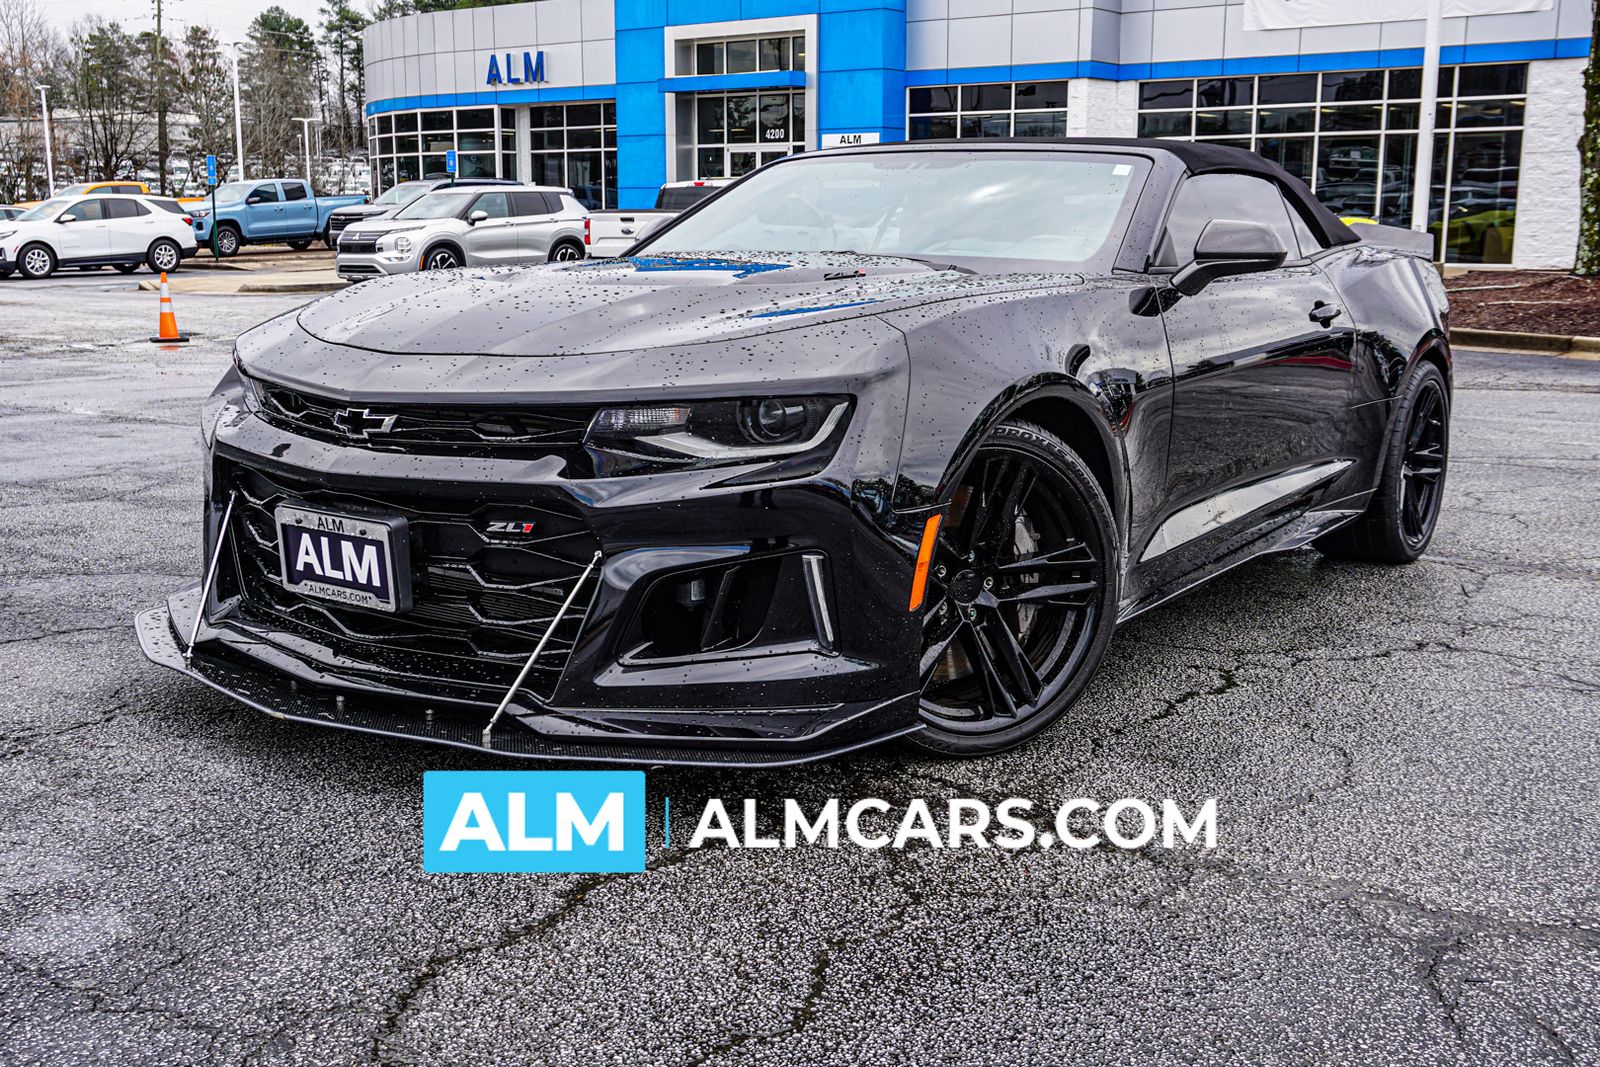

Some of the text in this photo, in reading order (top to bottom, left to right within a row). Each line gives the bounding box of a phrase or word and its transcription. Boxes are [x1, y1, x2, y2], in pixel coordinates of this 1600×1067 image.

[486, 50, 545, 85] ALM
[765, 128, 785, 139] 4200
[840, 134, 862, 145] ALM
[317, 516, 345, 533] ALM
[486, 521, 534, 533] ZL1
[295, 532, 381, 587] ALM
